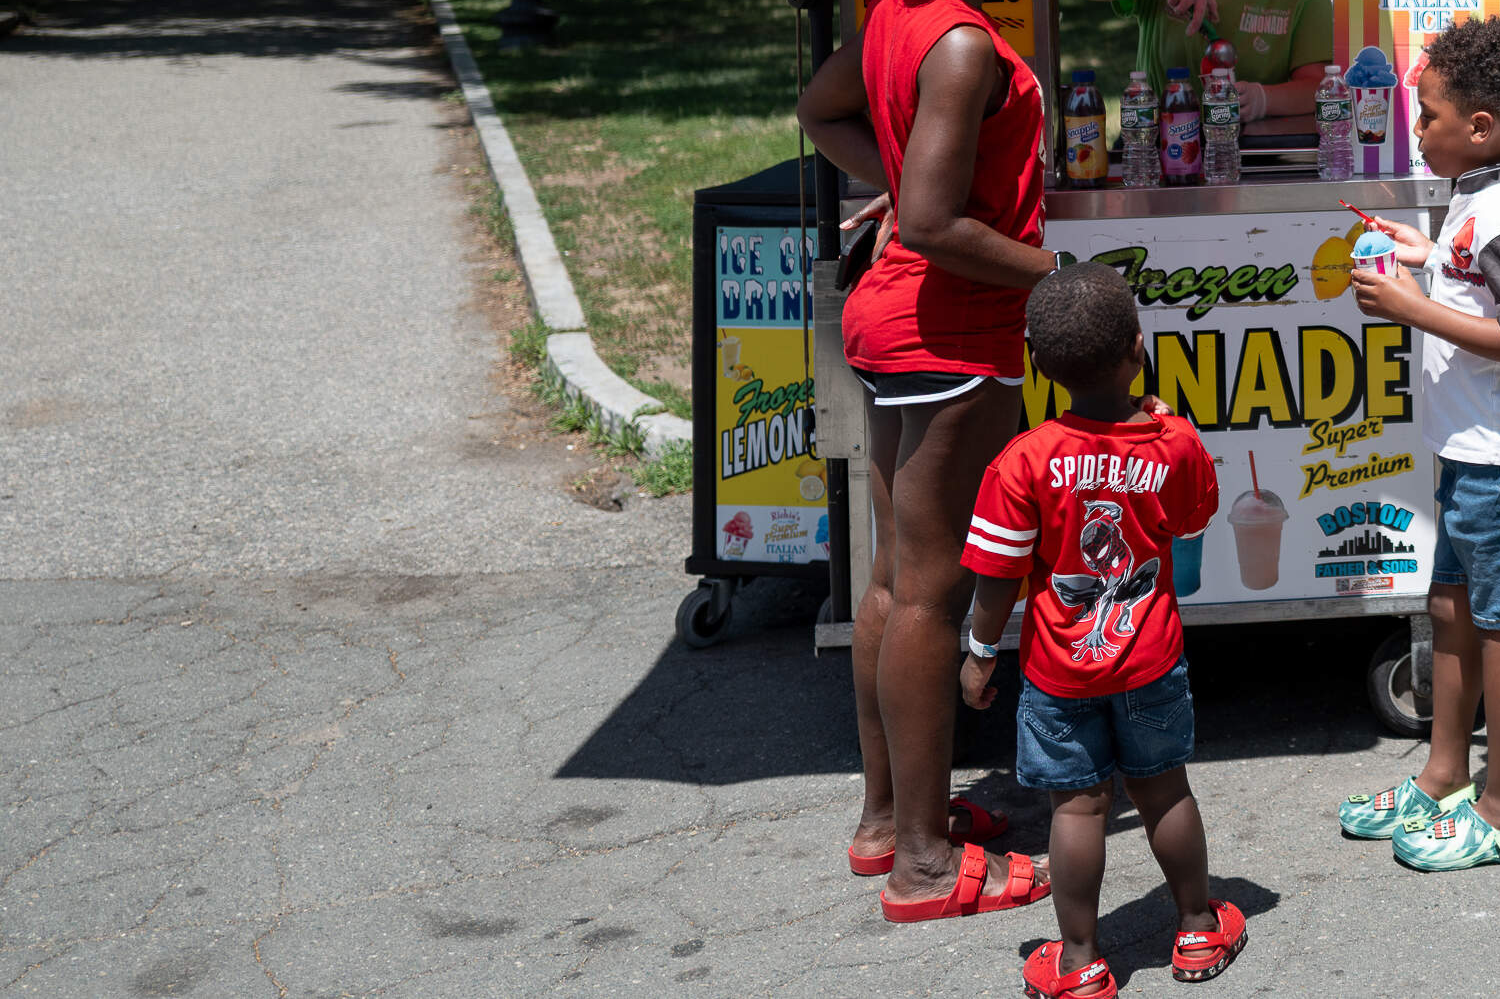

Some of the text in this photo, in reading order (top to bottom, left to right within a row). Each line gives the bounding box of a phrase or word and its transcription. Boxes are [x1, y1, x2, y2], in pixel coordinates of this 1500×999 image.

[1240, 12, 1289, 35] LEMONADE
[1413, 10, 1450, 31] ICE
[720, 234, 815, 276] ICE CO
[721, 279, 814, 320] DRIN
[733, 377, 815, 427] Froze
[721, 405, 816, 481] LEMON
[1304, 419, 1382, 454] Super
[1049, 453, 1170, 493] SPIDER-MAN
[1302, 455, 1413, 496] Premium
[1315, 501, 1415, 537] BOSTON
[766, 544, 807, 554] ITALIAN
[1315, 558, 1418, 578] FATHER & SONS
